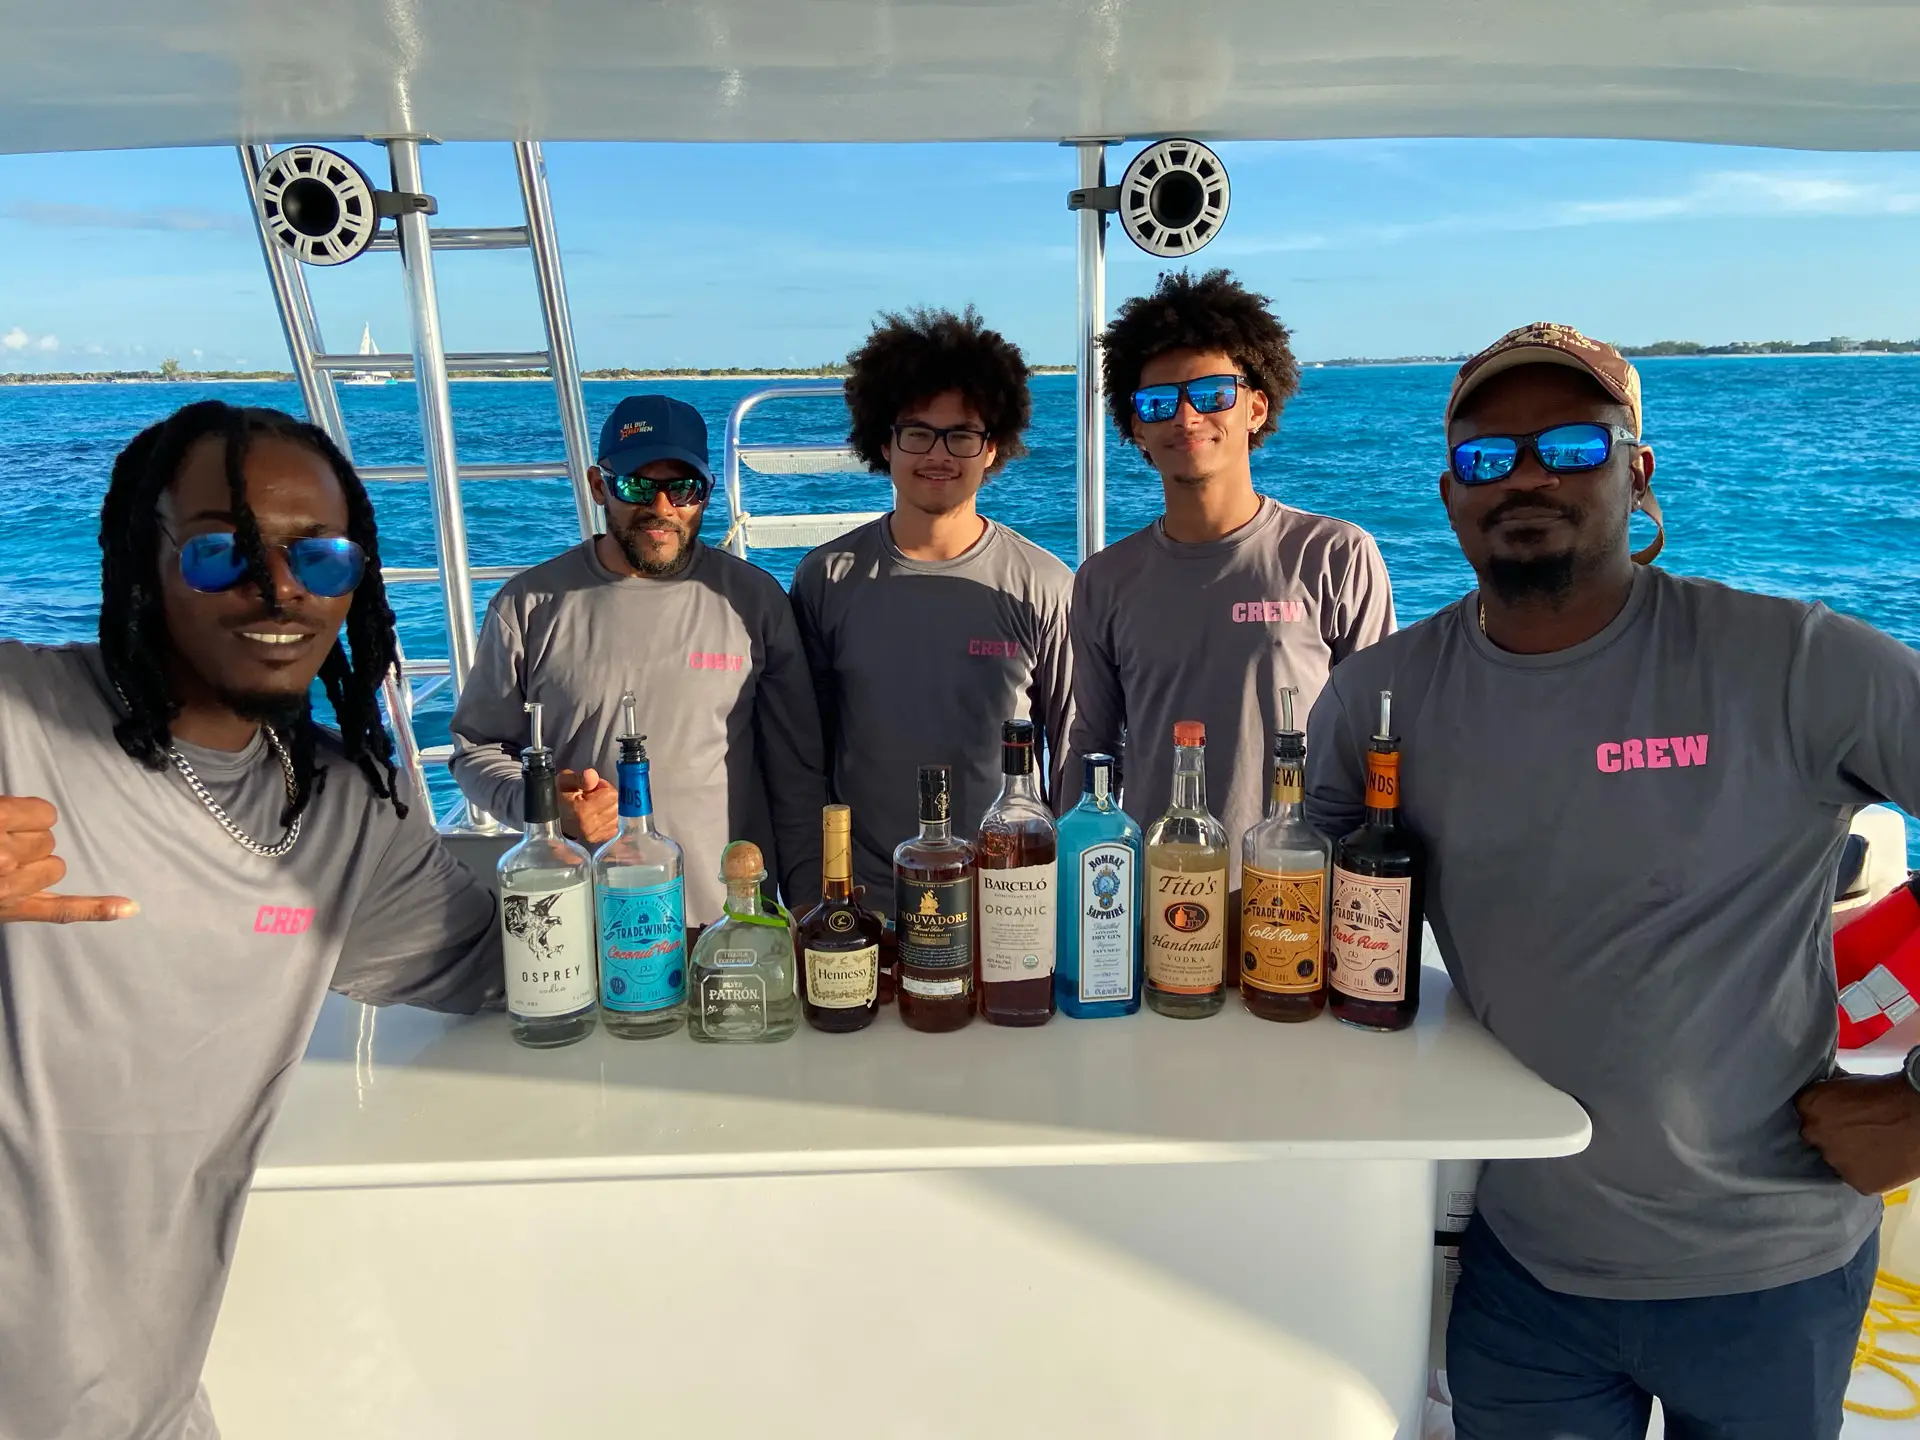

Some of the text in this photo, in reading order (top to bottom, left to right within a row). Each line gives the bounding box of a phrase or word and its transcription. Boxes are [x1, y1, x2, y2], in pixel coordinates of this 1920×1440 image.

[1232, 601, 1304, 623] CREW
[968, 637, 1020, 659] CREW
[689, 652, 744, 671] CREW
[1596, 734, 1709, 773] CREW
[1088, 854, 1125, 872] BOMBAY
[984, 876, 1048, 893] BARCELÓ
[1158, 875, 1217, 896] Tito's
[985, 904, 1047, 917] ORGANIC
[1086, 903, 1126, 920] SAPPHIRE
[1252, 906, 1306, 923] TRADEWINDS
[1335, 906, 1385, 930] TRADEWINDS
[616, 923, 672, 940] TRADEWINDS
[1248, 923, 1310, 942] Gold Rum
[1332, 923, 1390, 951] Dark Rum
[607, 944, 655, 959] Coconut
[1152, 933, 1222, 952] Handmade
[1166, 954, 1206, 964] VODKA
[521, 964, 581, 983] OSPREY
[817, 967, 868, 981] Hennessy
[539, 983, 567, 995] vodka
